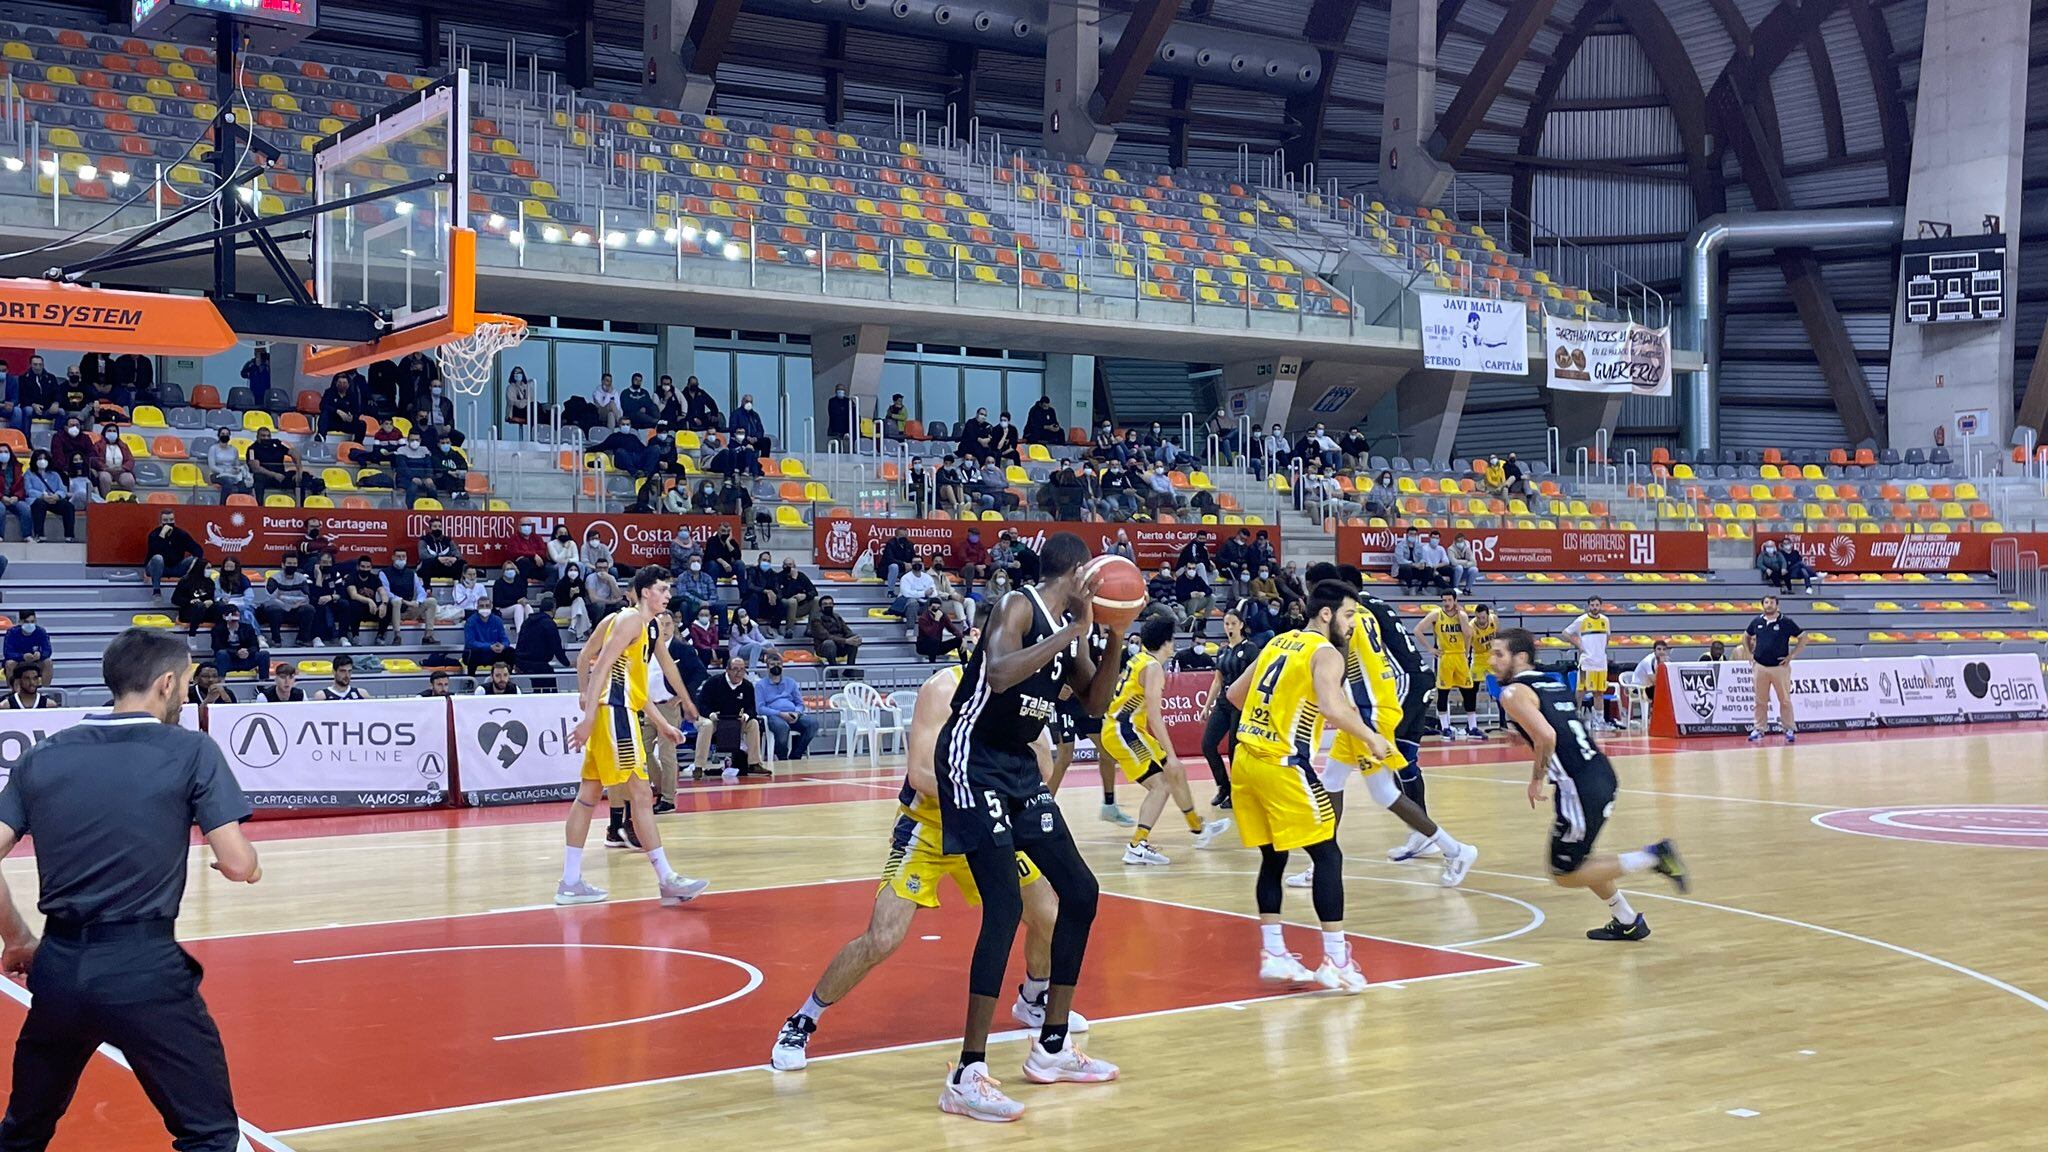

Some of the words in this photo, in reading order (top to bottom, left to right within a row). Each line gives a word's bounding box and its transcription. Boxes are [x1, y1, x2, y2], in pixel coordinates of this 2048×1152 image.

[1443, 299, 1467, 311] JAVI
[1471, 301, 1503, 314] MATÍA
[43, 304, 142, 325] SYSTEM
[1424, 355, 1461, 367] ETERNO
[1485, 360, 1523, 371] CAPITÁN
[263, 517, 304, 528] Puerto
[326, 518, 388, 531] Cartagena
[407, 515, 431, 537] LOS
[624, 525, 672, 542] Costa
[1137, 531, 1163, 540] Puerto
[1165, 531, 1175, 540] de
[1177, 531, 1216, 540] Cartana
[868, 539, 952, 558] Cagena
[1563, 533, 1577, 549] LOS
[1580, 533, 1625, 550] HABANEROS
[1870, 542, 1898, 557] ULTRA
[1907, 541, 1960, 557] MARATHON
[459, 544, 482, 555] TEL
[632, 543, 670, 557] Región
[1580, 554, 1606, 563] HOTEL
[1904, 556, 1950, 568] CARTAGENA
[1441, 624, 1463, 632] CANO
[1257, 655, 1287, 704] 4
[1683, 674, 1713, 690] MAC
[1820, 673, 1868, 694] TOMÁS
[1991, 678, 2039, 706] galian
[1160, 695, 1193, 709] osta
[1061, 713, 1074, 728] 14
[1162, 711, 1191, 726] egión
[297, 721, 416, 746] ATHOS
[312, 750, 402, 763] ONLINE
[1072, 750, 1095, 759] MOS!
[254, 795, 319, 804] CARTAGENA
[320, 795, 340, 804] C.B.
[357, 793, 409, 804] VAMOS!
[414, 792, 442, 806] cebé
[502, 788, 560, 801] CARTAGENA
[561, 786, 576, 796] C.B.
[983, 790, 1002, 818] 5
